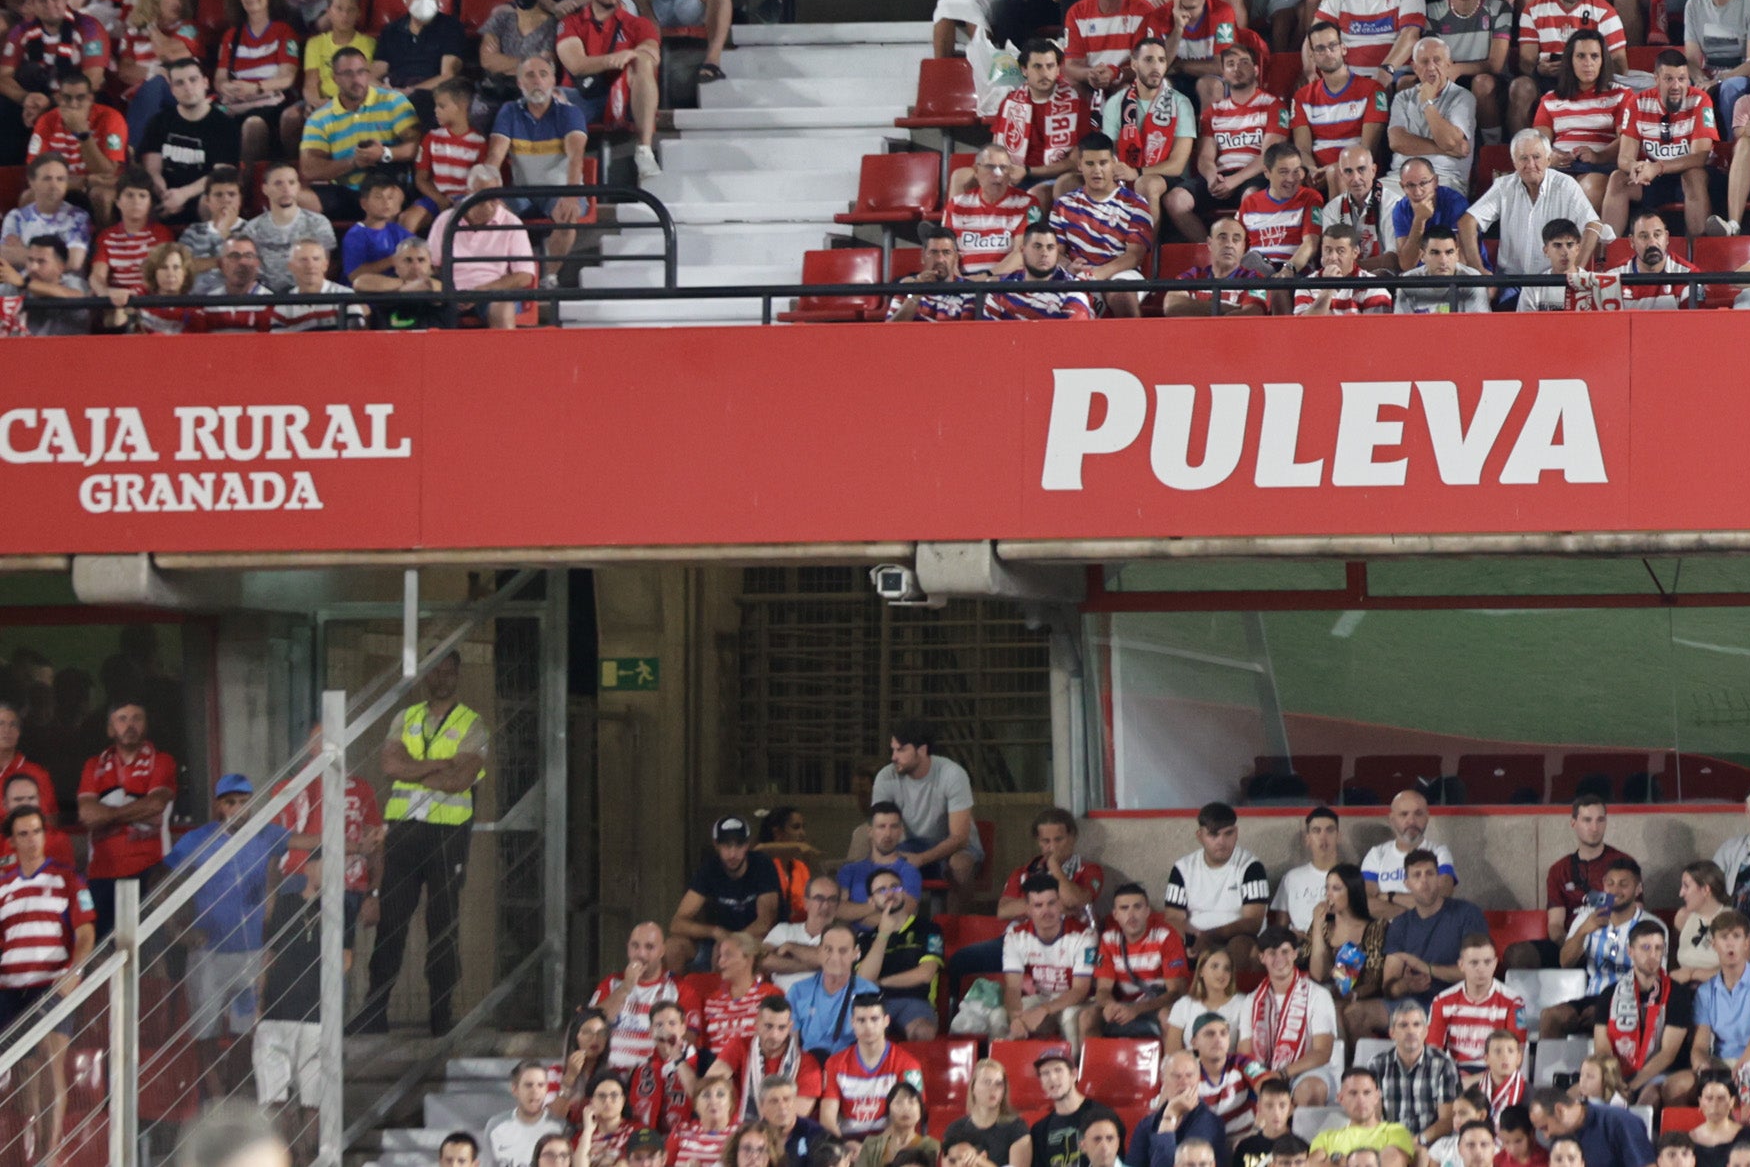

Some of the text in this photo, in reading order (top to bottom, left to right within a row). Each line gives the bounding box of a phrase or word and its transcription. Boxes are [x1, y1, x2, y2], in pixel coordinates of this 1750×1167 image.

[1582, 10, 1590, 26] 8
[1215, 129, 1263, 149] Platzi
[1644, 139, 1690, 158] Platzi
[962, 231, 1010, 249] Platzi
[0, 404, 411, 466] CAJA RURAL
[1042, 368, 1608, 491] PULEVA
[79, 471, 323, 514] GRANADA
[1380, 869, 1407, 881] adi
